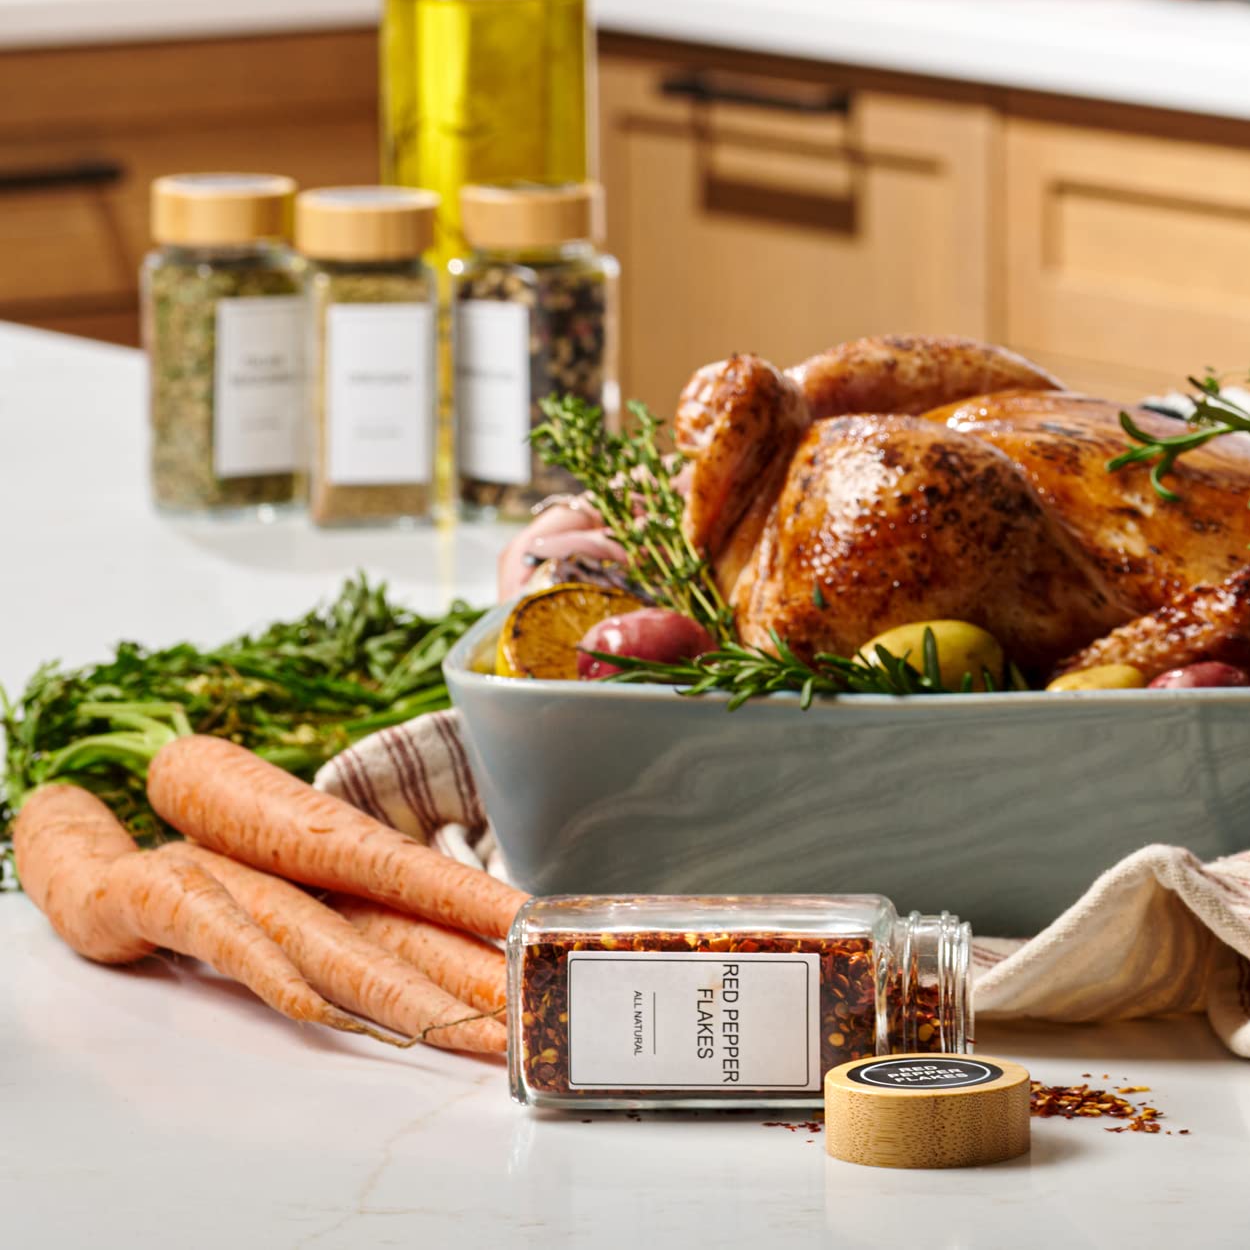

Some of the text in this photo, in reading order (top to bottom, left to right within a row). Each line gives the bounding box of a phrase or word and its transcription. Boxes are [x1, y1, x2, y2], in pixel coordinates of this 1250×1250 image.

[633, 990, 644, 1056] ALL NATURAL
[696, 988, 714, 1059] FLAKES
[722, 963, 740, 1083] RED PEPPER
[887, 1068, 963, 1078] PEPPER
[893, 1073, 969, 1083] FLAKES
